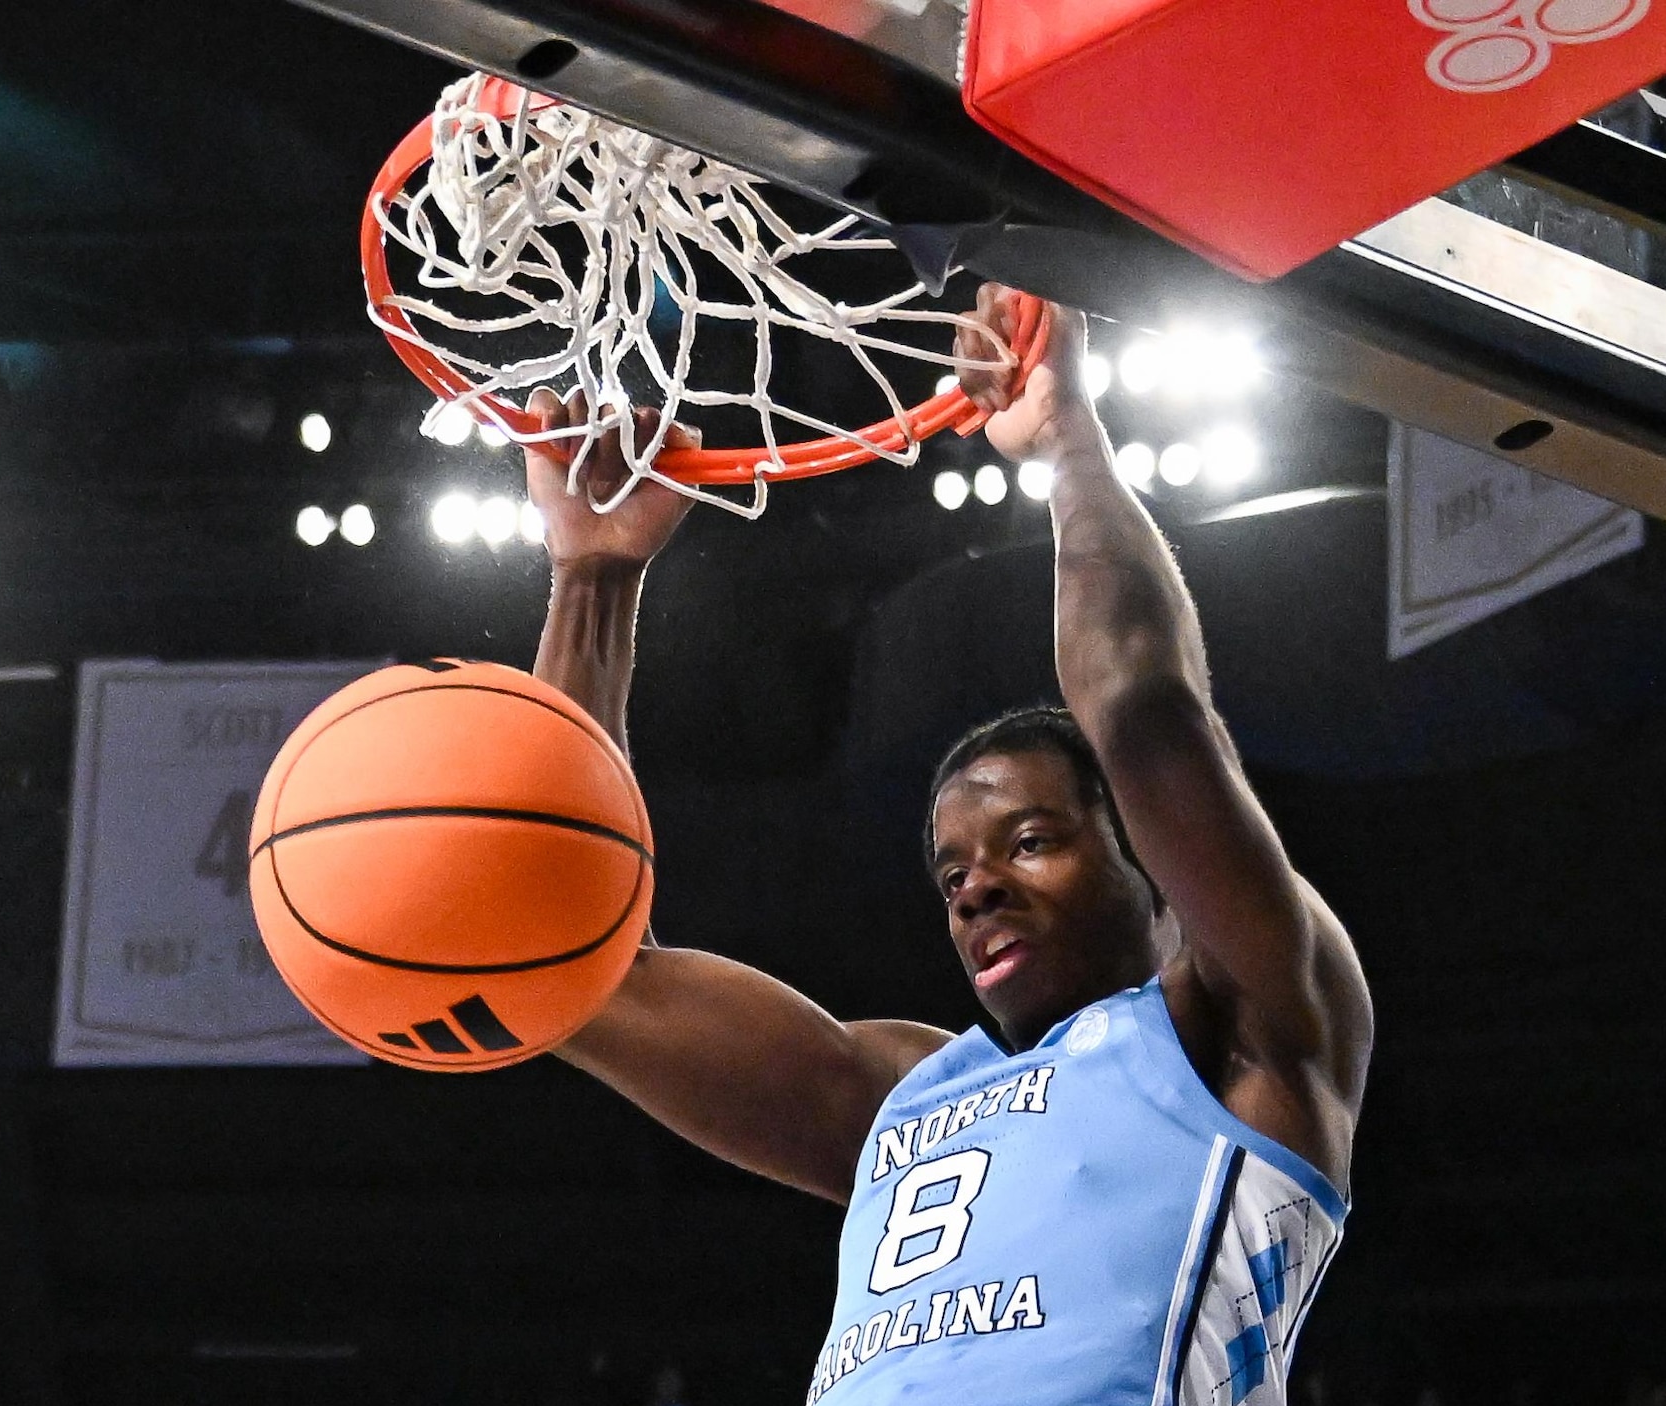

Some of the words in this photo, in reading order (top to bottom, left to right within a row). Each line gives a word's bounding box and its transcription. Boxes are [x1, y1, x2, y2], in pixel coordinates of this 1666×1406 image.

[182, 704, 286, 751] SCOTT
[870, 1064, 1056, 1184] NORTH
[867, 1145, 993, 1297] 8
